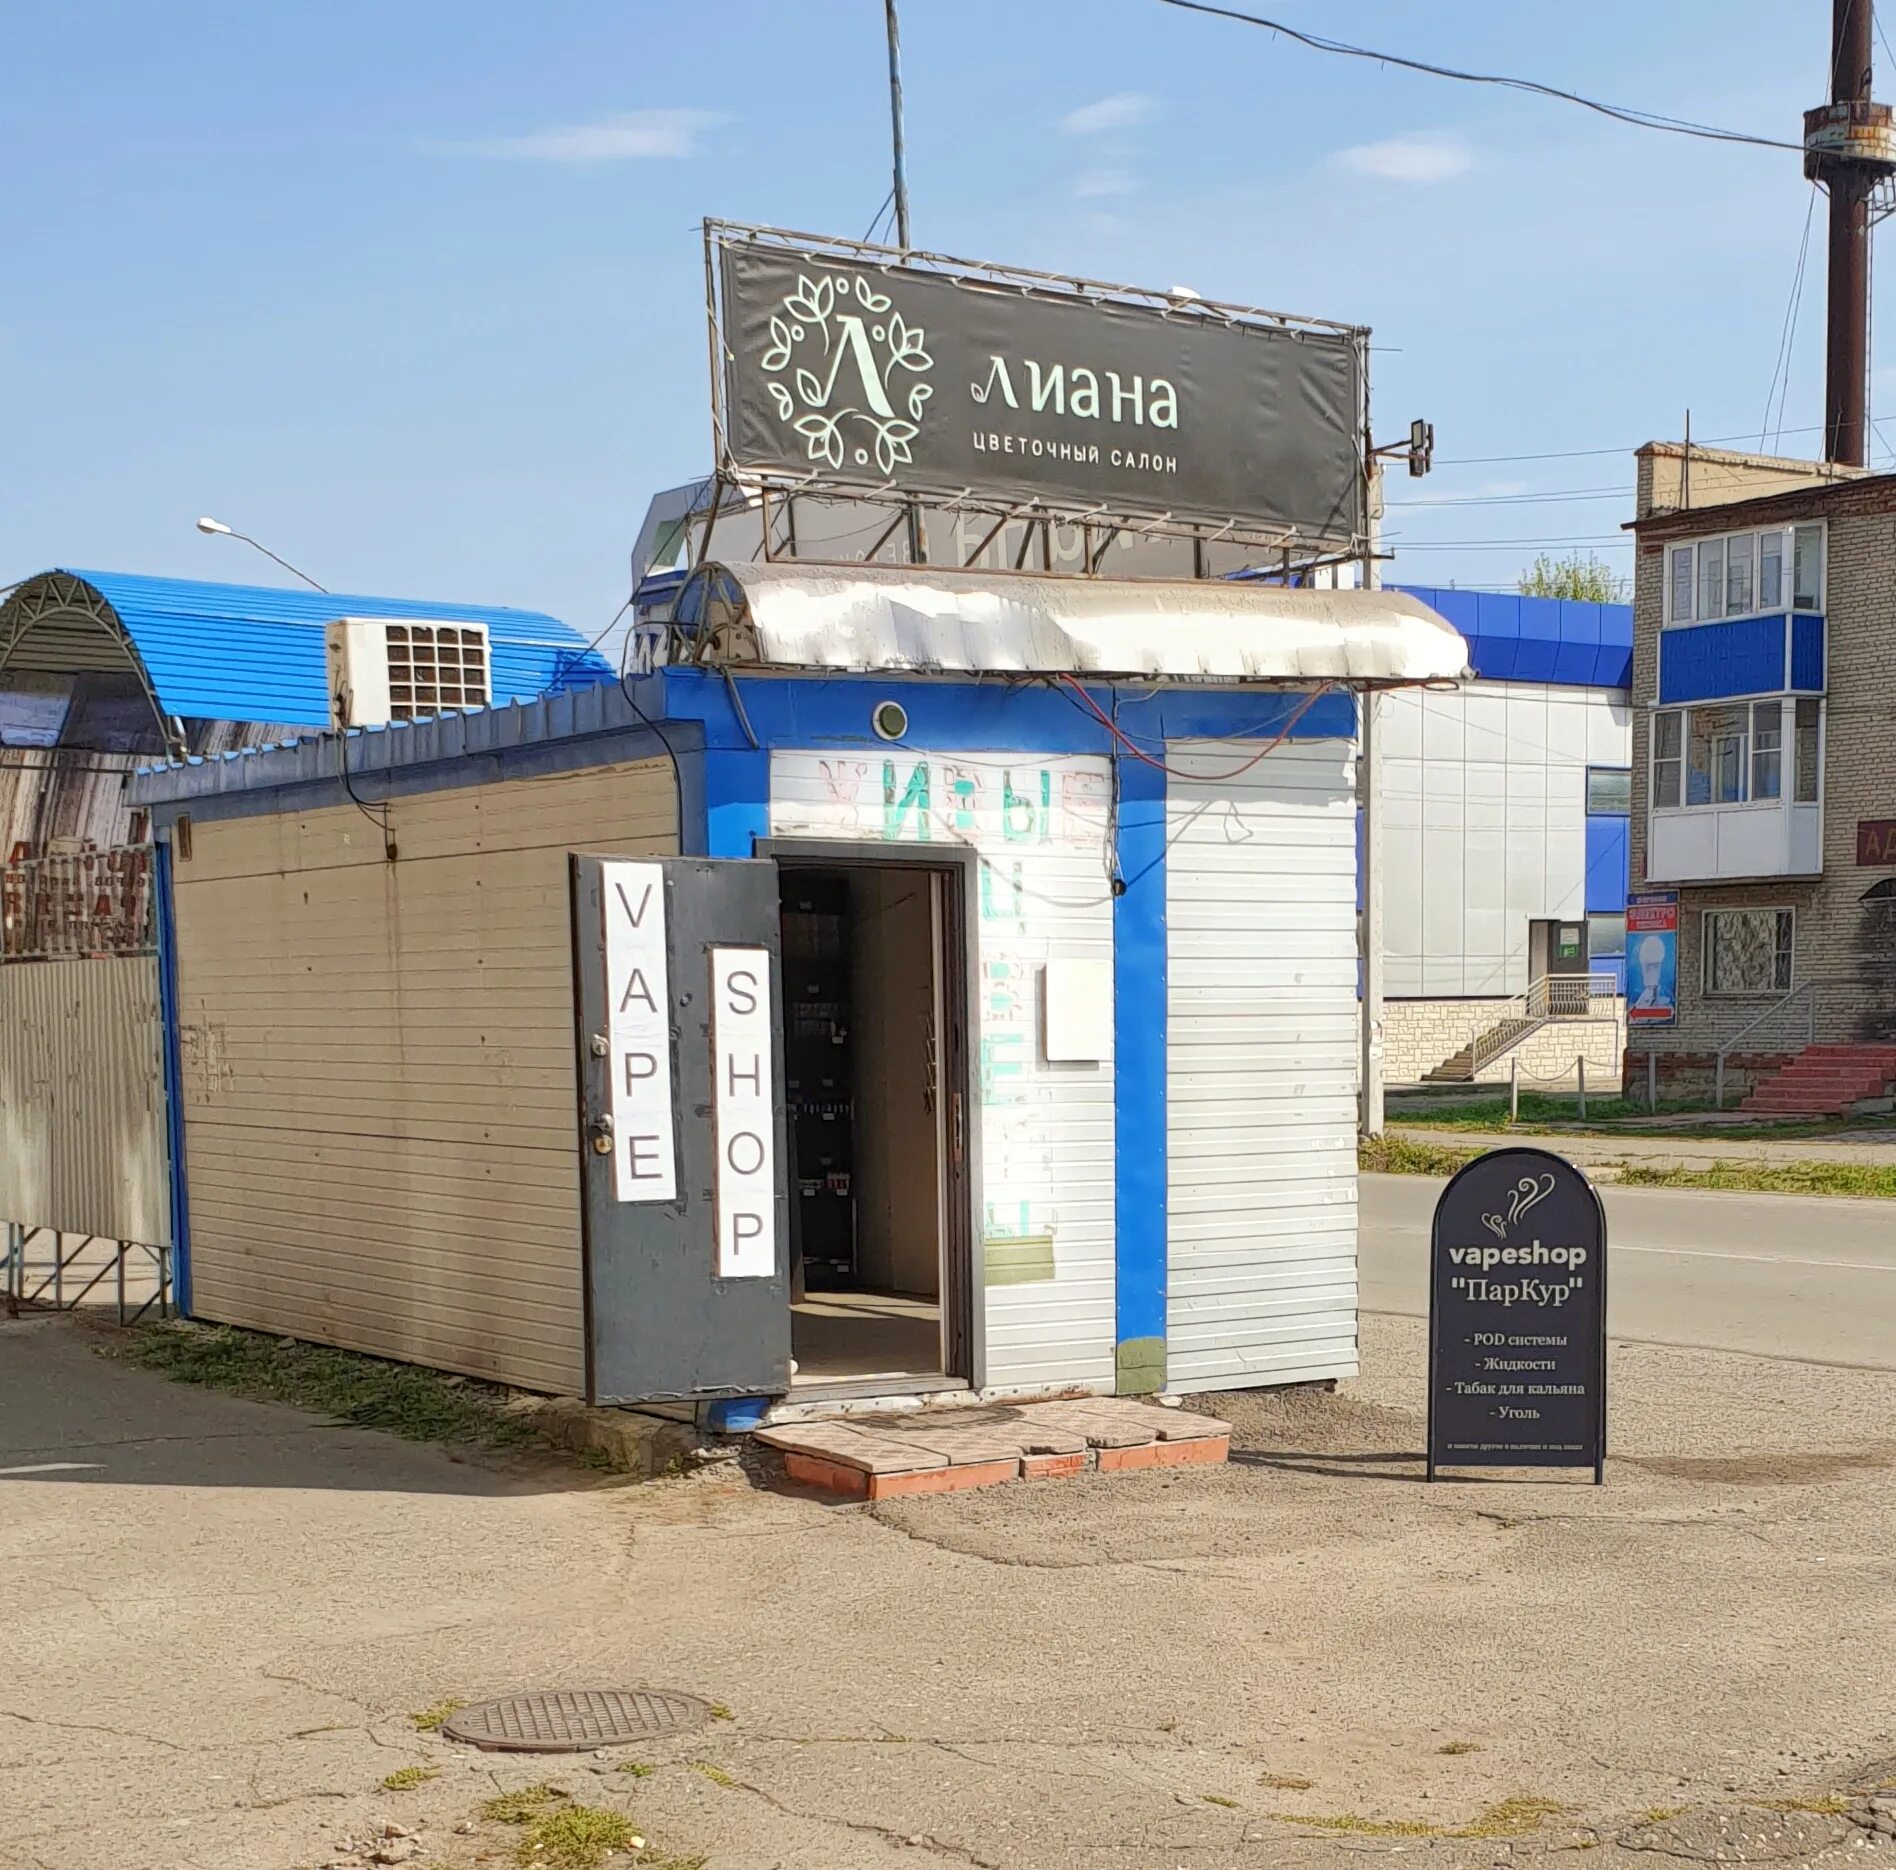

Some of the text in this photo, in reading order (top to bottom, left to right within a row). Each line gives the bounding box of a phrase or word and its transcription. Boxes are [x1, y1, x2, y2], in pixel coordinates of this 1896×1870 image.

[970, 355, 1178, 430] Лиана
[973, 431, 1177, 474] ЦВЕТОЧНЫЙ САЛОН
[615, 882, 664, 1180] VAPE
[726, 970, 766, 1256] SHOP
[1449, 1240, 1587, 1271] vapeshop
[1451, 1277, 1583, 1307] "ПарКур"
[1473, 1333, 1506, 1346] POD
[1507, 1335, 1568, 1346] системы
[1483, 1357, 1556, 1371] Жидкости
[1454, 1381, 1496, 1394] Табак
[1498, 1384, 1524, 1395] для
[1528, 1384, 1585, 1395] кальяна
[1498, 1406, 1541, 1419] Уголь
